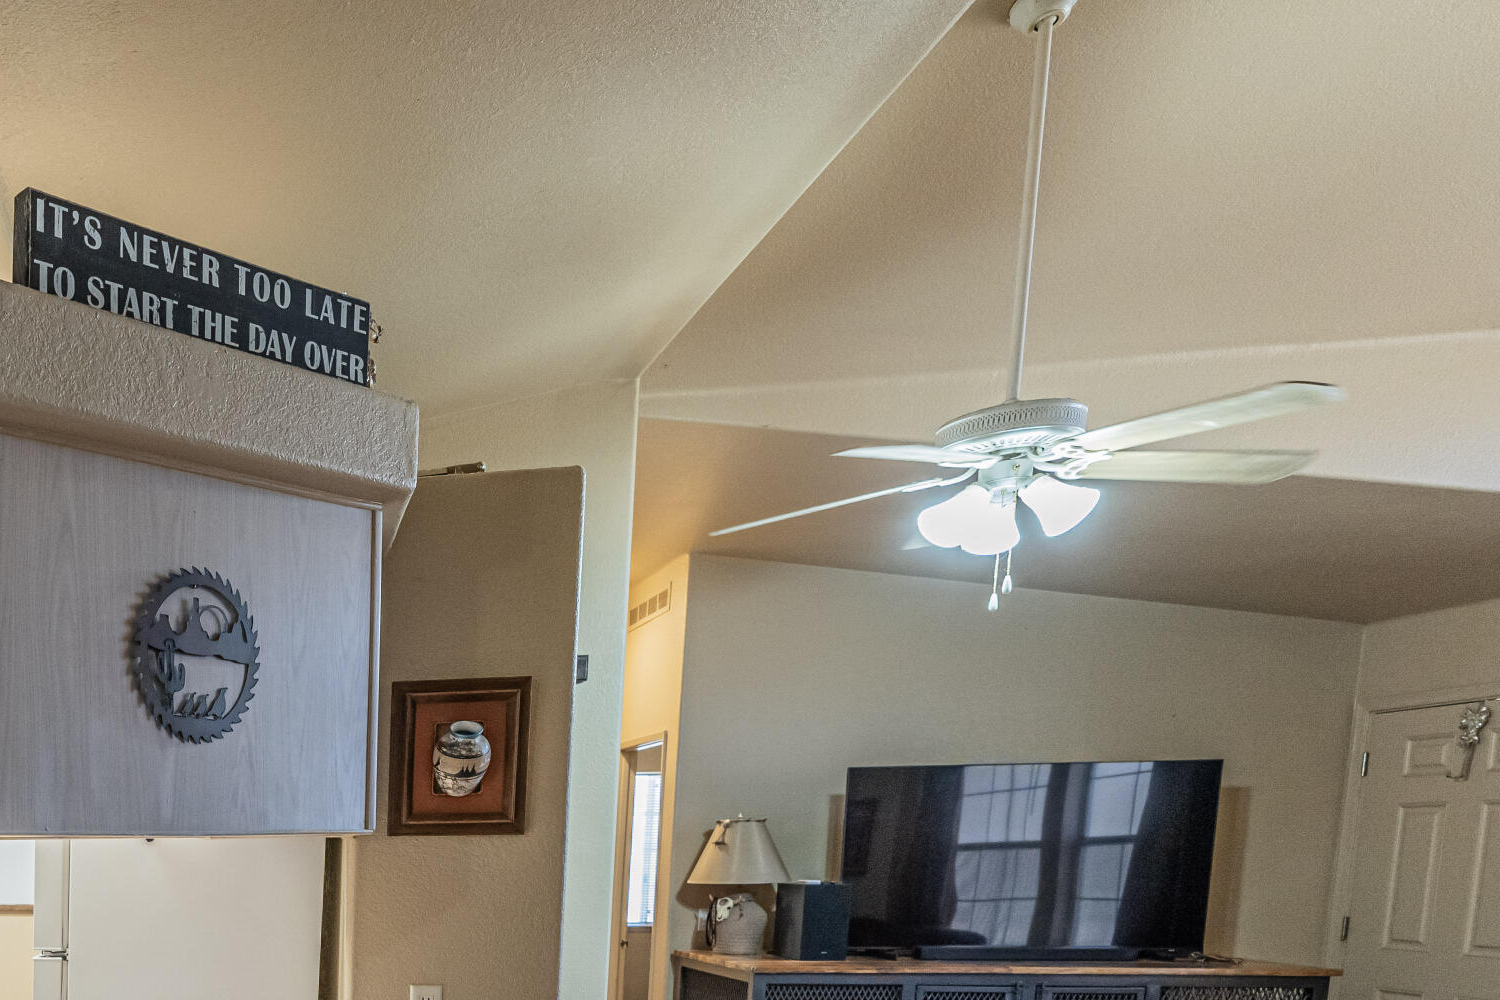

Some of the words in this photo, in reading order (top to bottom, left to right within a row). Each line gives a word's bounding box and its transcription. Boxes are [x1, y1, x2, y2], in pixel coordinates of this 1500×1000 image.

[34, 258, 75, 301] TO
[87, 276, 178, 330] START
[187, 304, 240, 348] THE
[249, 322, 297, 364] DAY
[304, 341, 365, 385] OVER
[35, 197, 102, 250] IT'S
[120, 226, 220, 289] NEVER
[233, 263, 291, 309] TOO
[305, 289, 368, 335] LATE
